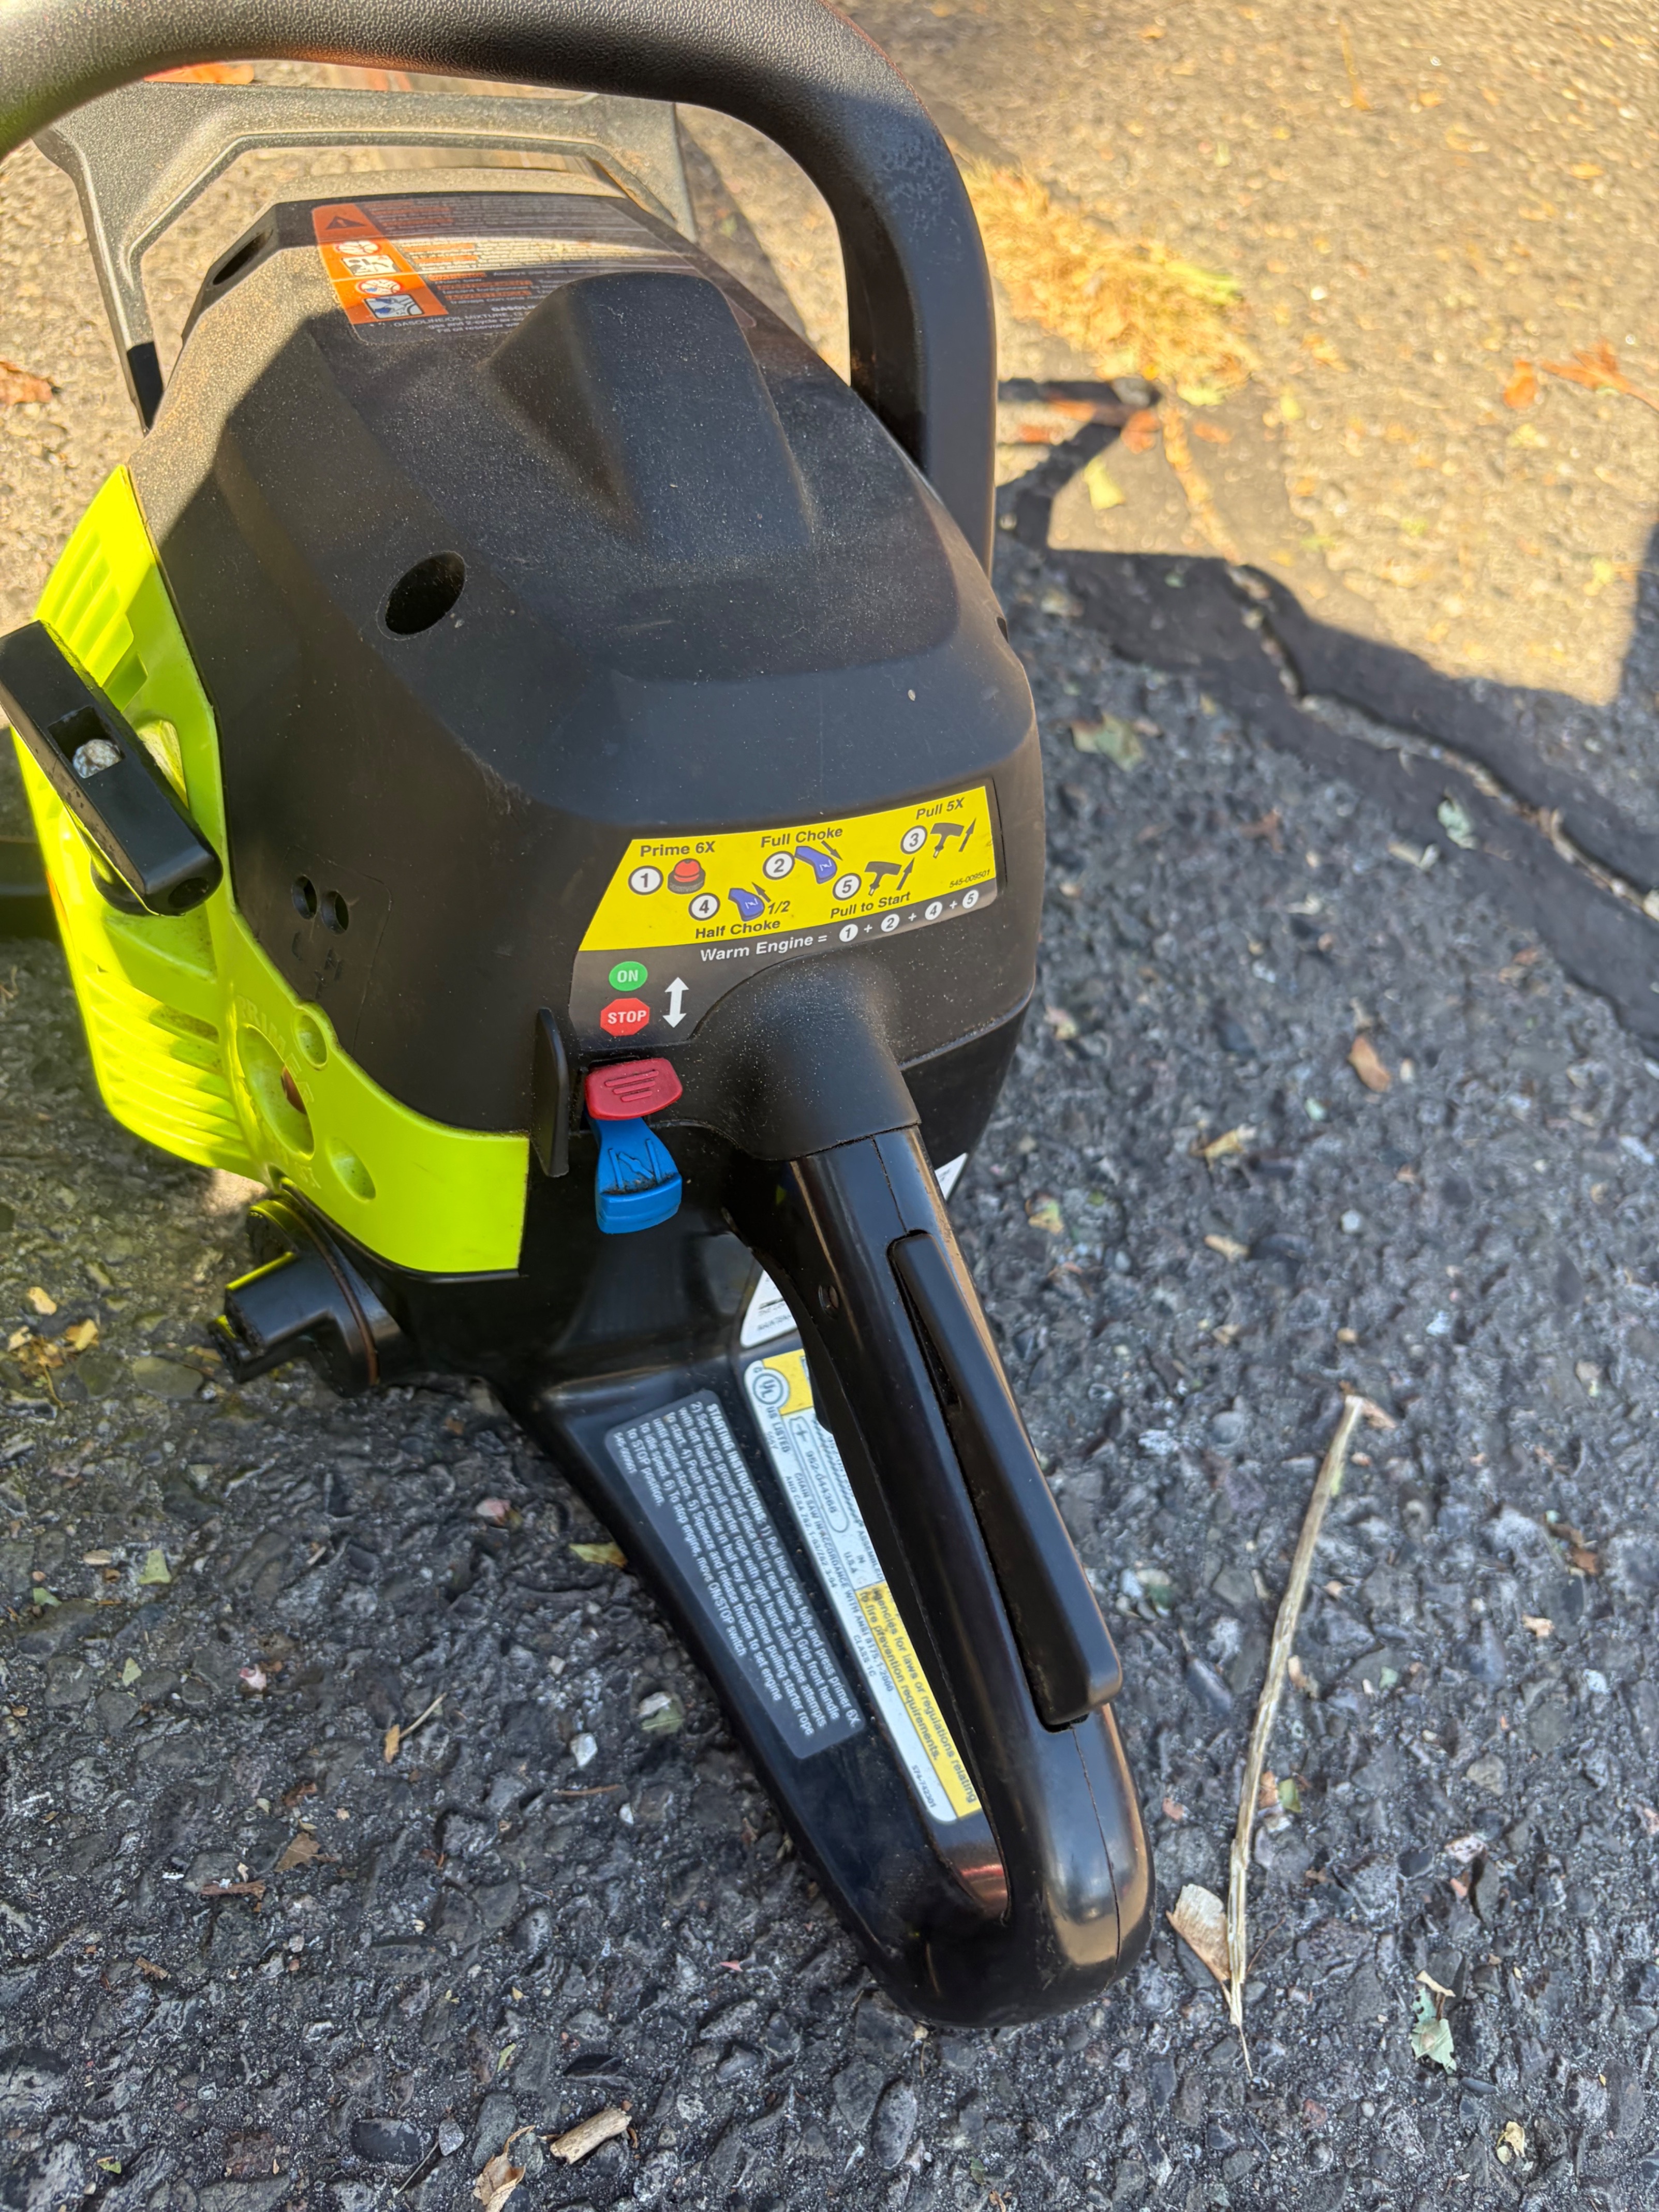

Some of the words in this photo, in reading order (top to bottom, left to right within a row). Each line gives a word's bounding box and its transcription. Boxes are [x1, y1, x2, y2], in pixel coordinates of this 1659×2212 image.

[916, 803, 943, 820] Pull
[946, 797, 965, 812] 5X
[761, 834, 792, 849] Full
[795, 826, 843, 844] Choke
[640, 843, 692, 858] Prime
[695, 841, 716, 854] 6X
[949, 869, 991, 888] 545-009501
[768, 900, 791, 915] 1/2
[830, 904, 857, 919] Pull
[861, 901, 874, 914] to
[877, 891, 911, 909] Start
[695, 925, 725, 940] Half
[729, 918, 781, 936] Choke
[700, 946, 750, 962] Warm
[756, 936, 814, 957] Engine
[617, 970, 639, 983] ON
[607, 1009, 647, 1024] STOP
[665, 1412, 676, 1423] to
[678, 1406, 693, 1427] with
[690, 1401, 703, 1413] 2)
[639, 1422, 650, 1433] to
[653, 1418, 668, 1438] until
[695, 1413, 710, 1430] Set
[707, 1403, 735, 1450] STARTING
[626, 1428, 638, 1439] to
[644, 1433, 657, 1450] idle
[670, 1423, 686, 1447] start.
[687, 1427, 701, 1443] left
[703, 1430, 717, 1448] saw
[773, 1421, 790, 1453] LISTED
[631, 1439, 651, 1465] STOP
[661, 1439, 680, 1469] engine
[680, 1448, 692, 1459] 4)
[693, 1443, 712, 1467] hand
[711, 1449, 723, 1462] on
[651, 1450, 670, 1479] speed.
[685, 1459, 702, 1483] Push
[703, 1467, 719, 1485] and
[641, 1466, 664, 1506] position.
[663, 1479, 675, 1491] 6)
[675, 1470, 692, 1498] starts.
[715, 1463, 739, 1495] ground
[728, 1450, 766, 1523] INSTRUCTIONS:
[668, 1490, 680, 1503] To
[687, 1499, 700, 1511] 5)
[695, 1483, 712, 1505] blue
[710, 1486, 728, 1504] pull
[731, 1496, 747, 1514] and
[673, 1503, 688, 1523] stop
[705, 1505, 723, 1533] choke
[720, 1504, 739, 1533] starter
[692, 1511, 716, 1550] Squeeze
[717, 1533, 729, 1544] in
[738, 1515, 757, 1539] place
[760, 1524, 772, 1536] 1)
[682, 1524, 701, 1556] engine,
[733, 1535, 749, 1557] rope
[751, 1539, 767, 1560] foot
[765, 1536, 782, 1555] Pull
[795, 1472, 809, 1498] CHAIN
[806, 1500, 820, 1518] SAW
[845, 1590, 860, 1613] WITH
[708, 1550, 725, 1569] and
[722, 1543, 738, 1562] half
[696, 1556, 714, 1582] move
[731, 1562, 745, 1582] way
[744, 1557, 759, 1578] with
[760, 1559, 772, 1570] in
[774, 1555, 790, 1577] blue
[718, 1569, 738, 1603] release
[753, 1579, 771, 1602] right
[765, 1570, 781, 1590] rear
[783, 1577, 803, 1606] choke
[708, 1582, 735, 1624] ON/STOP
[739, 1583, 756, 1602] and
[764, 1601, 782, 1627] hand
[775, 1590, 795, 1626] handle.
[797, 1606, 813, 1627] fully
[865, 1604, 878, 1623] fire
[733, 1603, 754, 1639] throttle
[748, 1602, 772, 1644] continue
[790, 1625, 803, 1639] 3)
[727, 1625, 746, 1656] switch
[748, 1638, 760, 1651] to
[775, 1627, 793, 1650] until
[796, 1638, 812, 1661] Grip
[807, 1628, 824, 1648] and
[753, 1651, 768, 1667] set
[765, 1644, 788, 1679] pulling
[814, 1647, 835, 1676] press
[871, 1625, 905, 1682] prevention
[786, 1650, 806, 1683] engine
[807, 1660, 825, 1686] front
[761, 1668, 782, 1701] engine
[782, 1678, 803, 1710] starter
[827, 1676, 851, 1709] primer
[801, 1684, 826, 1727] attempts
[818, 1685, 839, 1719] handle
[797, 1711, 814, 1735] rope
[845, 1709, 861, 1727] 6X.
[894, 1636, 907, 1651] for
[902, 1654, 918, 1680] laws
[914, 1681, 925, 1693] or
[922, 1696, 955, 1758] regulations
[951, 1760, 976, 1803] relating
[901, 1685, 939, 1760] requirements.
